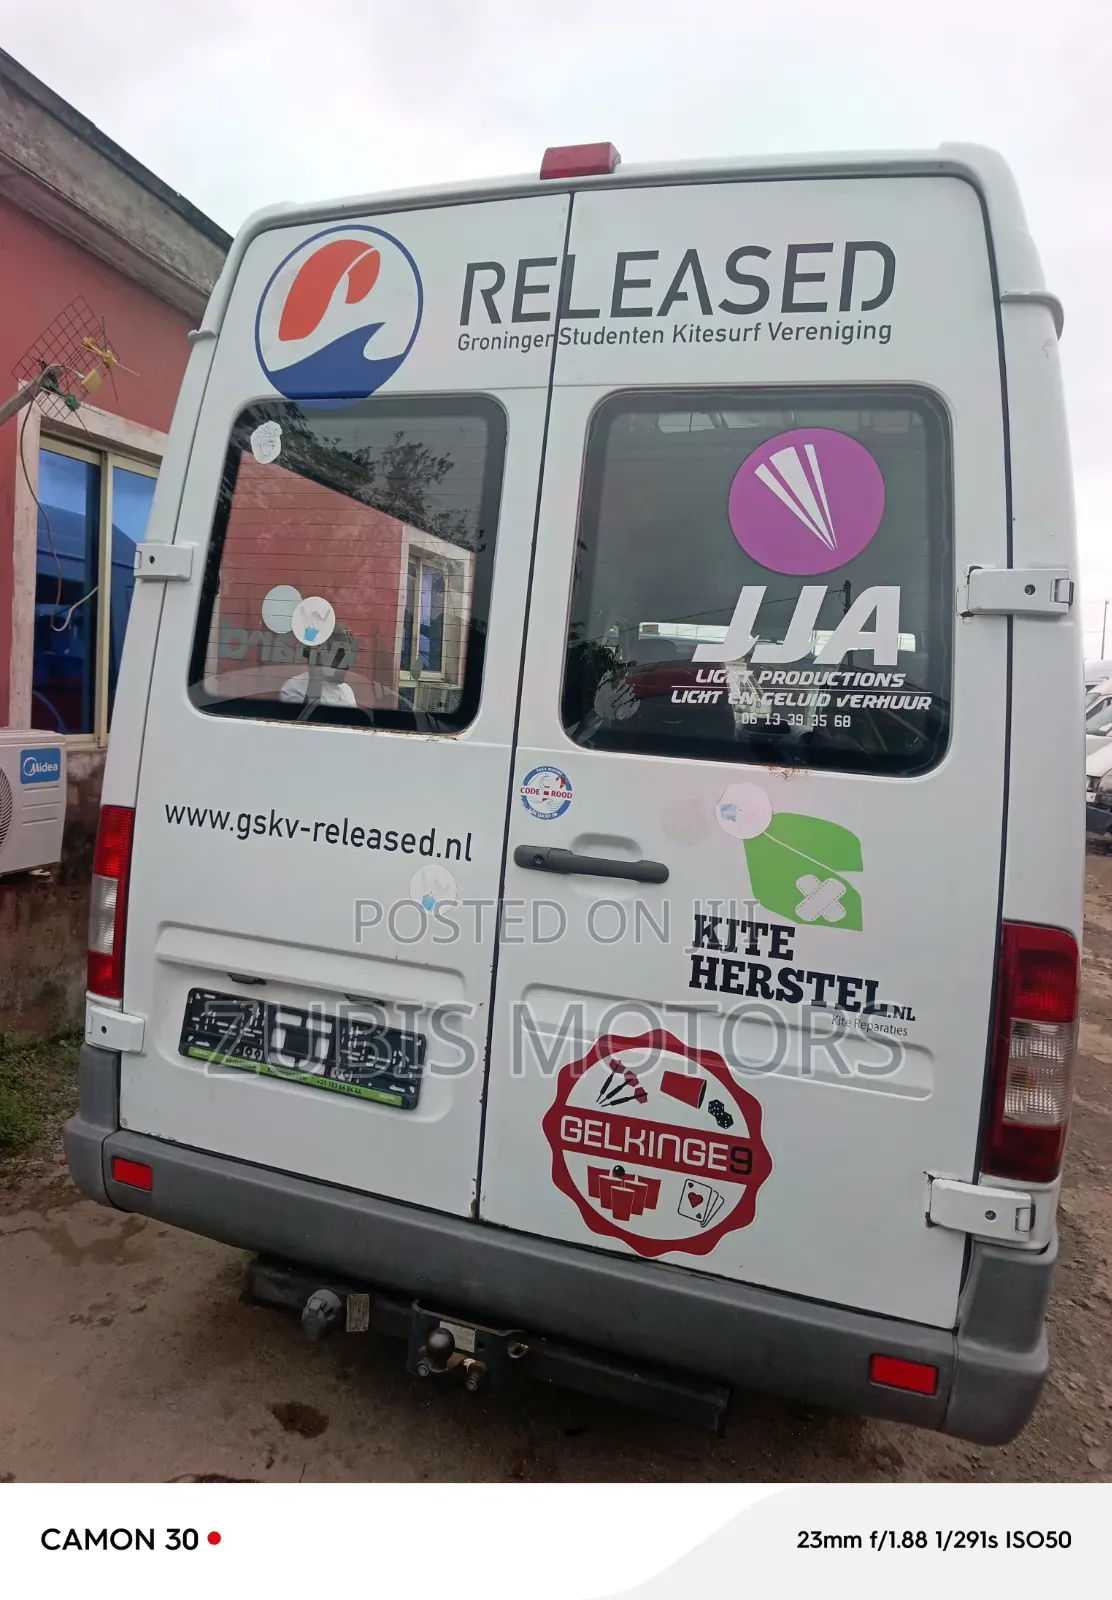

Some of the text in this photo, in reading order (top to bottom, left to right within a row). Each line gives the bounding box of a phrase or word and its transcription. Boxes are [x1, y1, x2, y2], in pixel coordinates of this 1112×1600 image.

[459, 240, 897, 326] RELEASED
[458, 320, 892, 353] Groninger Studenten Kitesurf Vereniging
[691, 585, 901, 666] JJA
[695, 669, 907, 688] LIGHT PRODUCTIONS
[671, 690, 932, 711] LICHT EN GELUID VERHUUR
[741, 713, 851, 728] 06 13 39 35 68
[24, 759, 58, 775] Midea
[520, 787, 573, 799] CODE ROOD
[165, 803, 472, 862] www.gskv-released.nl
[692, 914, 796, 961] KITE
[689, 954, 916, 1022] HERSTEL.NL
[831, 1014, 908, 1037] Kite Reparaties
[560, 1115, 753, 1176] GELKINGE9
